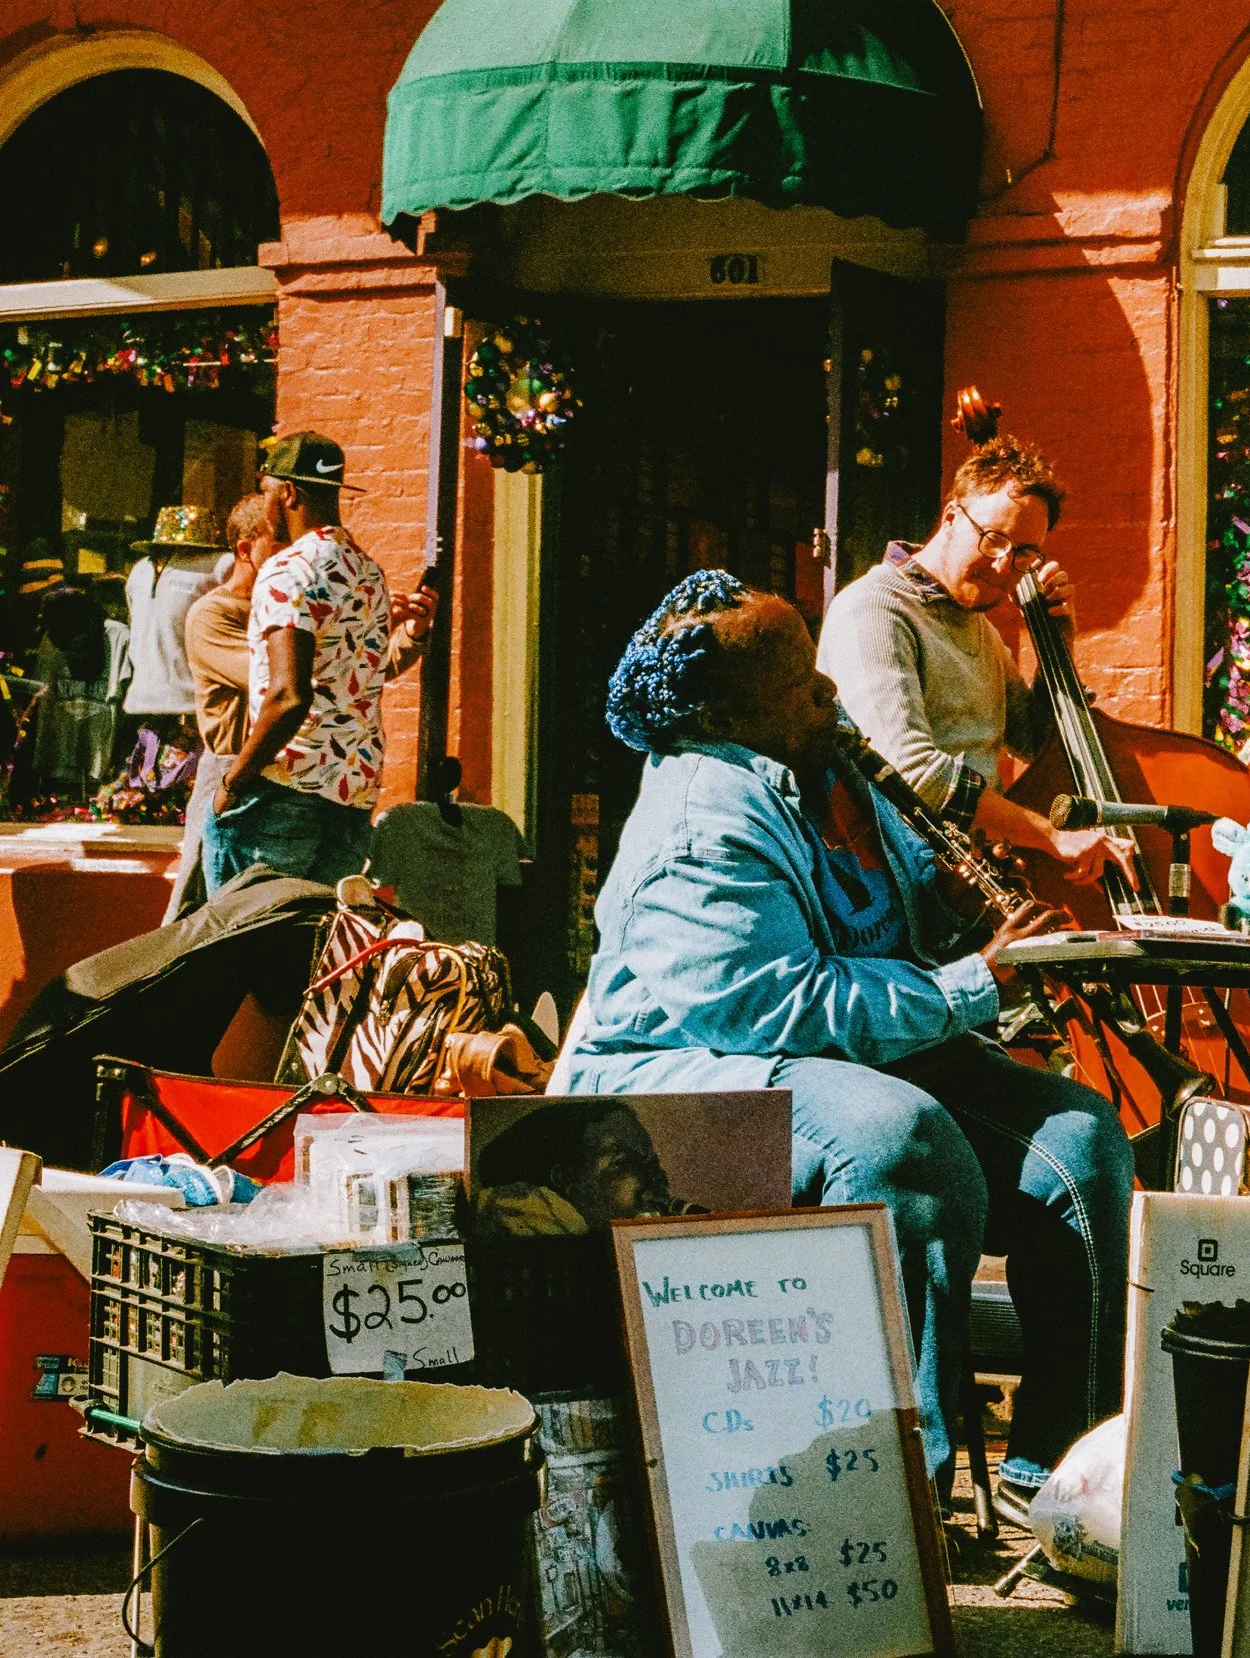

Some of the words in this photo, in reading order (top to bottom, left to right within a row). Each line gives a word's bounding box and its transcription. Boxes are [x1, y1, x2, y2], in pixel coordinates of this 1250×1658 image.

[1180, 1260, 1236, 1277] Square
[642, 1276, 758, 1307] WELCOME
[777, 1277, 807, 1293] TO
[329, 1278, 466, 1343] $25.00
[671, 1306, 834, 1353] DOREEN'S
[413, 1347, 460, 1368] Small
[727, 1354, 819, 1393] JAZZ!
[702, 1408, 754, 1433] CDs
[826, 1448, 879, 1482] $25
[839, 1538, 887, 1568] $25
[846, 1579, 899, 1609] $50
